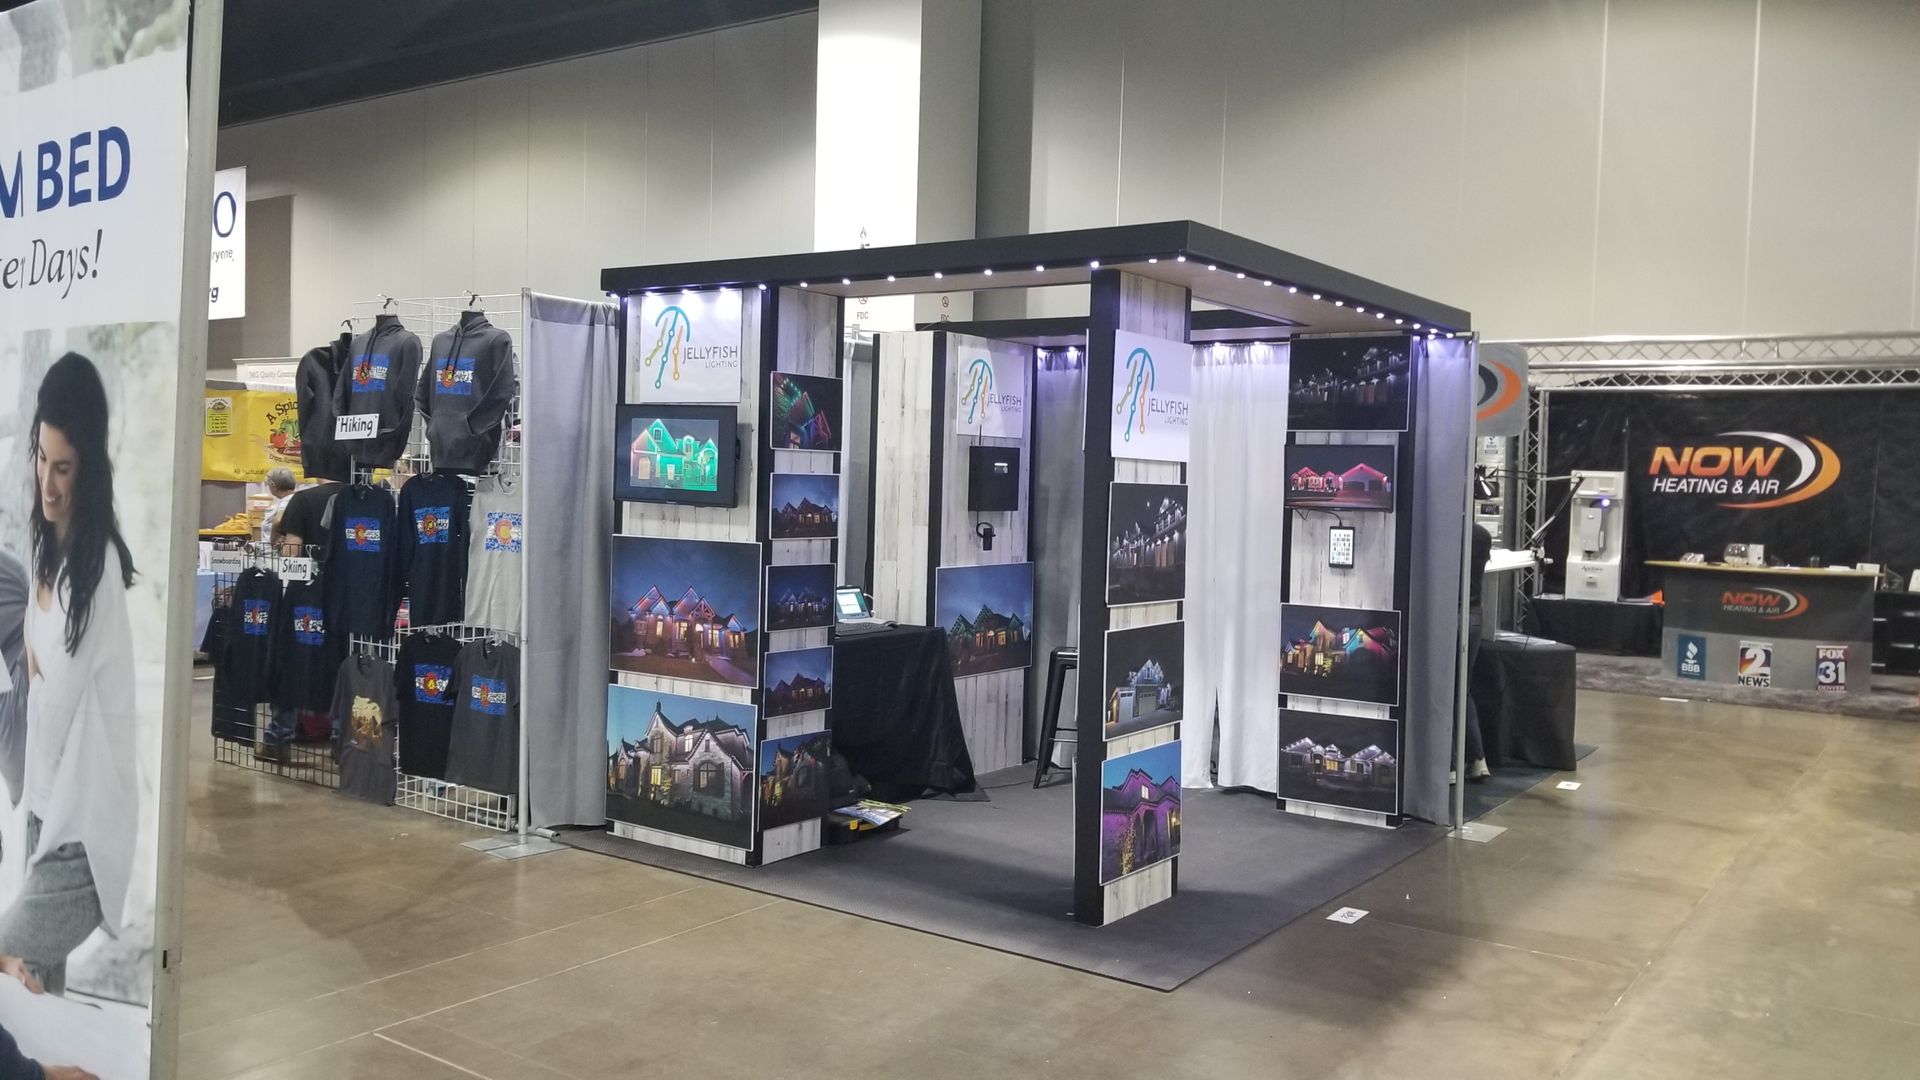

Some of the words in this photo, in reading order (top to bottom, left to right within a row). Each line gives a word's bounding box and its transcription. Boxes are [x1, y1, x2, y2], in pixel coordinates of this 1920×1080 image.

[37, 126, 131, 212] BED
[28, 229, 103, 300] Days!
[857, 312, 869, 320] FDC
[683, 346, 738, 365] JELLYFISH
[705, 360, 738, 369] LIGHTING
[987, 393, 1022, 407] JELLYFISH
[1147, 398, 1189, 416] JELLYFISH
[1001, 405, 1022, 414] LIGHTING
[266, 413, 277, 425] A
[340, 417, 373, 436] Hiking
[1164, 417, 1189, 426] LIGHTING
[1649, 446, 1785, 477] NOW
[1652, 478, 1727, 494] HEATING
[1732, 479, 1744, 494] &
[1747, 479, 1780, 495] AIR
[211, 556, 241, 567] Snowboarding
[282, 558, 308, 579] Skiing
[1721, 591, 1783, 607] NOW
[1723, 604, 1757, 613] HEATING
[1740, 647, 1771, 676] 2
[1818, 648, 1845, 660] FOX
[1681, 662, 1701, 673] BBB
[1818, 661, 1846, 684] 31
[1738, 675, 1770, 688] NEWS
